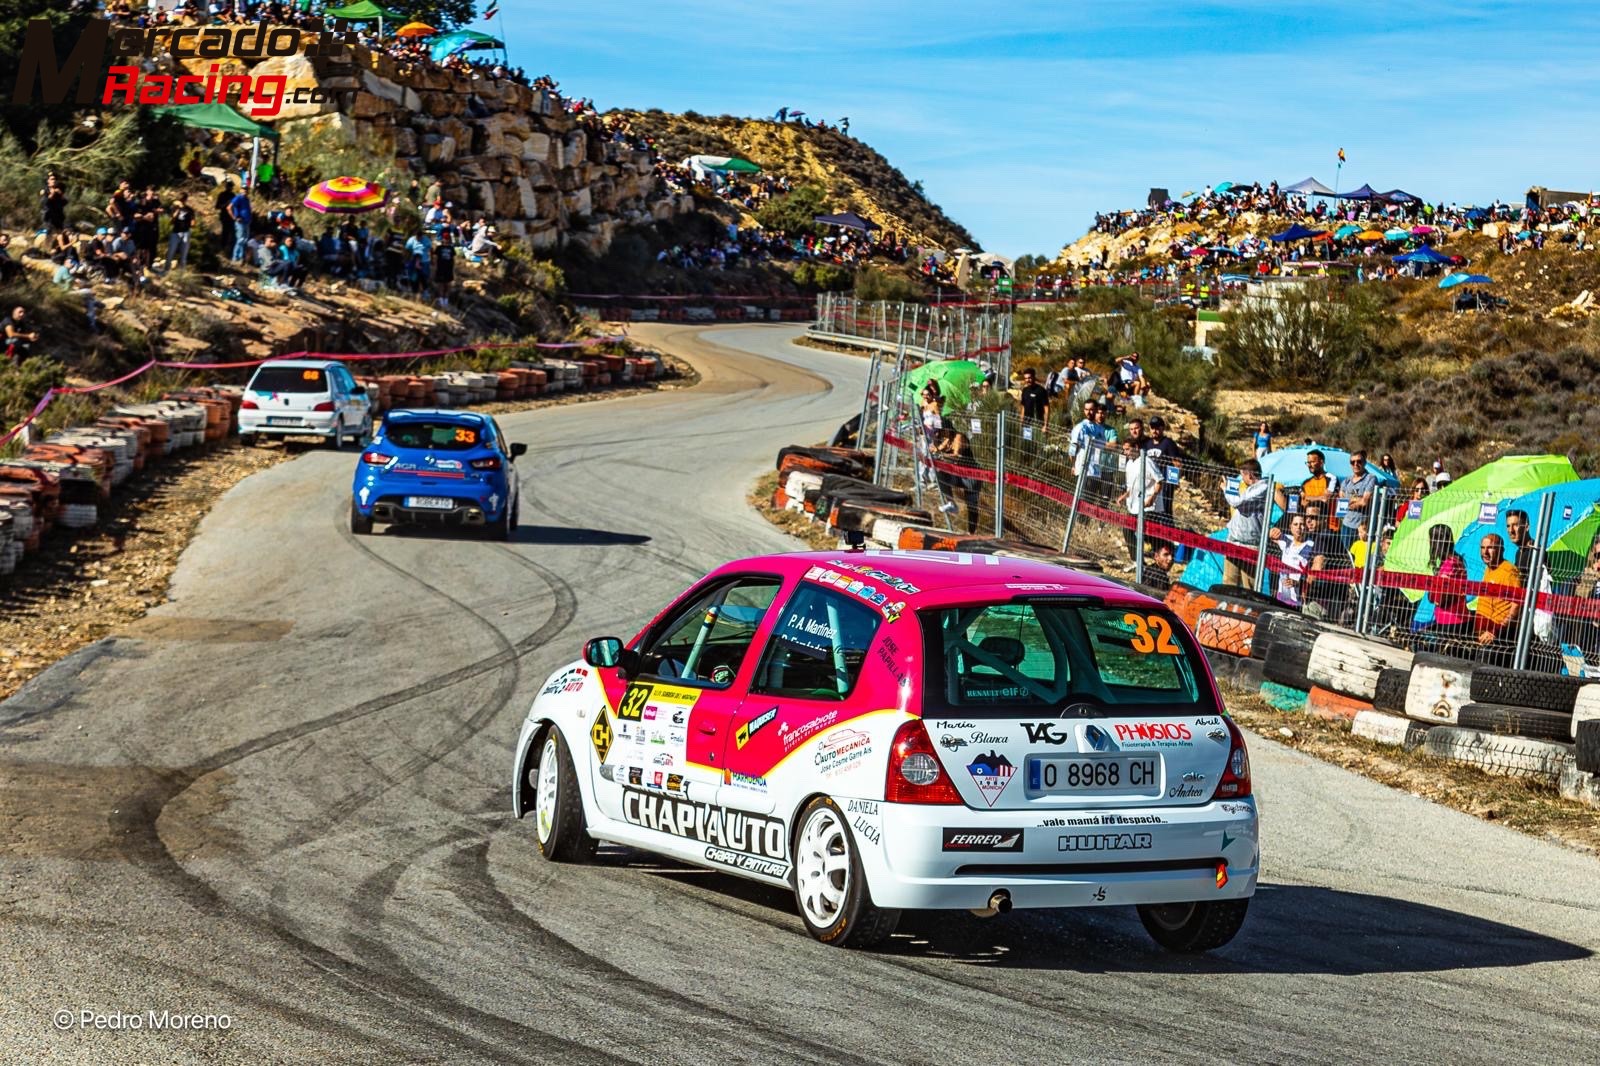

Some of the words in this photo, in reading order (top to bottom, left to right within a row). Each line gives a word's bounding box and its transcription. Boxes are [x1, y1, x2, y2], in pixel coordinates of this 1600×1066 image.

[455, 429, 475, 443] 33
[1123, 613, 1180, 655] 32
[623, 688, 648, 716] 32
[1195, 717, 1220, 726] Abril
[969, 731, 1008, 744] Blanca
[1020, 722, 1067, 744] TAG
[1068, 762, 1119, 787] 8968
[1130, 761, 1154, 785] CH
[1169, 783, 1203, 798] Andrea
[848, 800, 878, 815] DANIELA
[1067, 816, 1099, 826] mamá
[854, 816, 881, 845] LUCÍA
[951, 835, 1002, 845] FERRER
[1058, 833, 1152, 851] HUITAR
